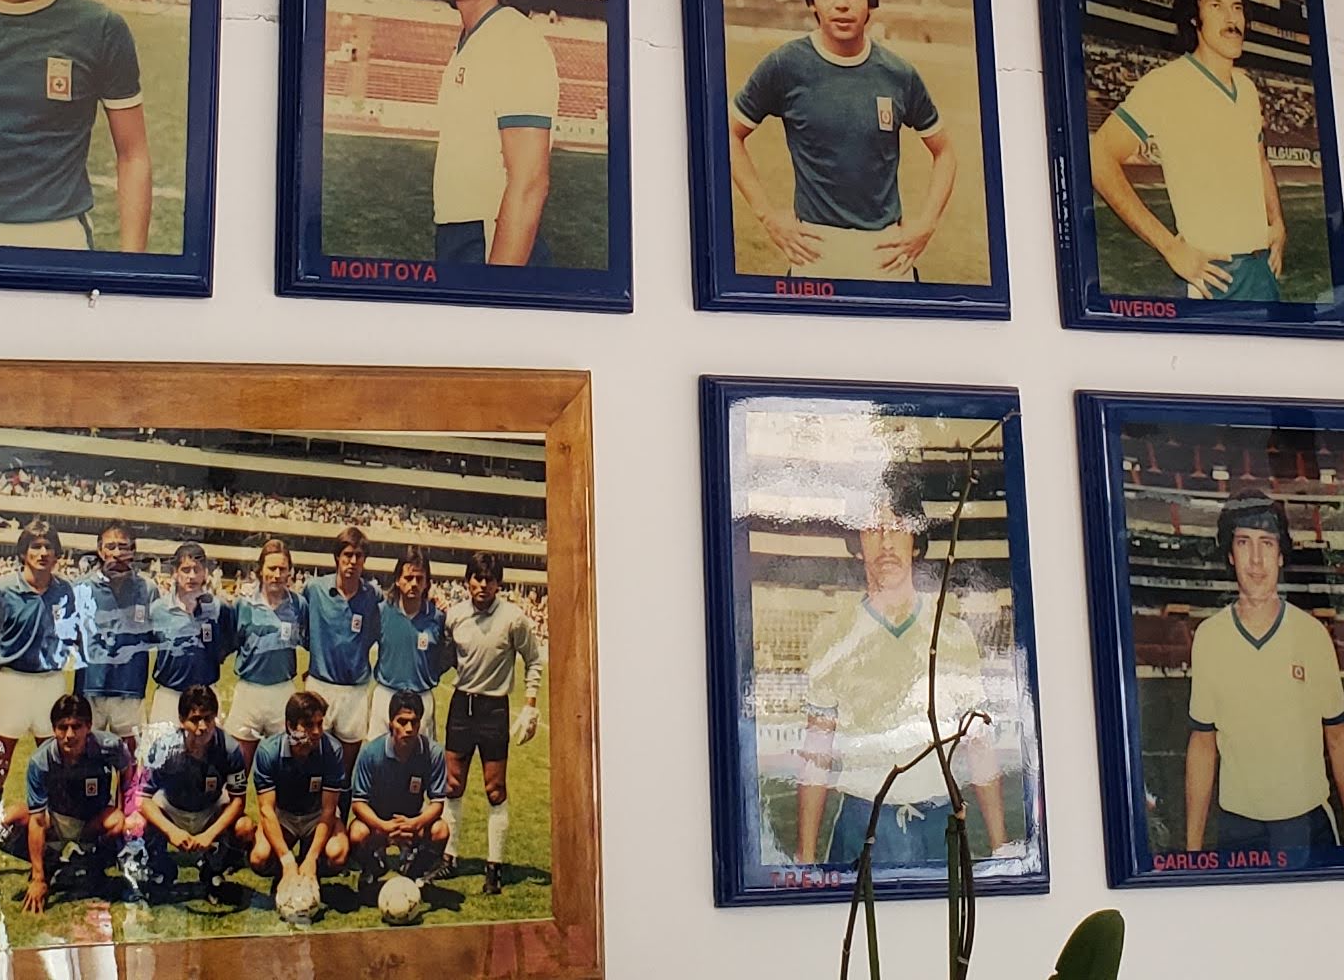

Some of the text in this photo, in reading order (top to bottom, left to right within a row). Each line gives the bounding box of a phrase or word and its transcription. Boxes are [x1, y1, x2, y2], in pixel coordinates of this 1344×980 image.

[331, 261, 437, 282] MONTOYA
[776, 281, 834, 298] RUBIO
[1109, 300, 1177, 317] VIVEROS
[1153, 850, 1288, 871] CARLOS JARA S
[769, 871, 842, 888] TREJO
